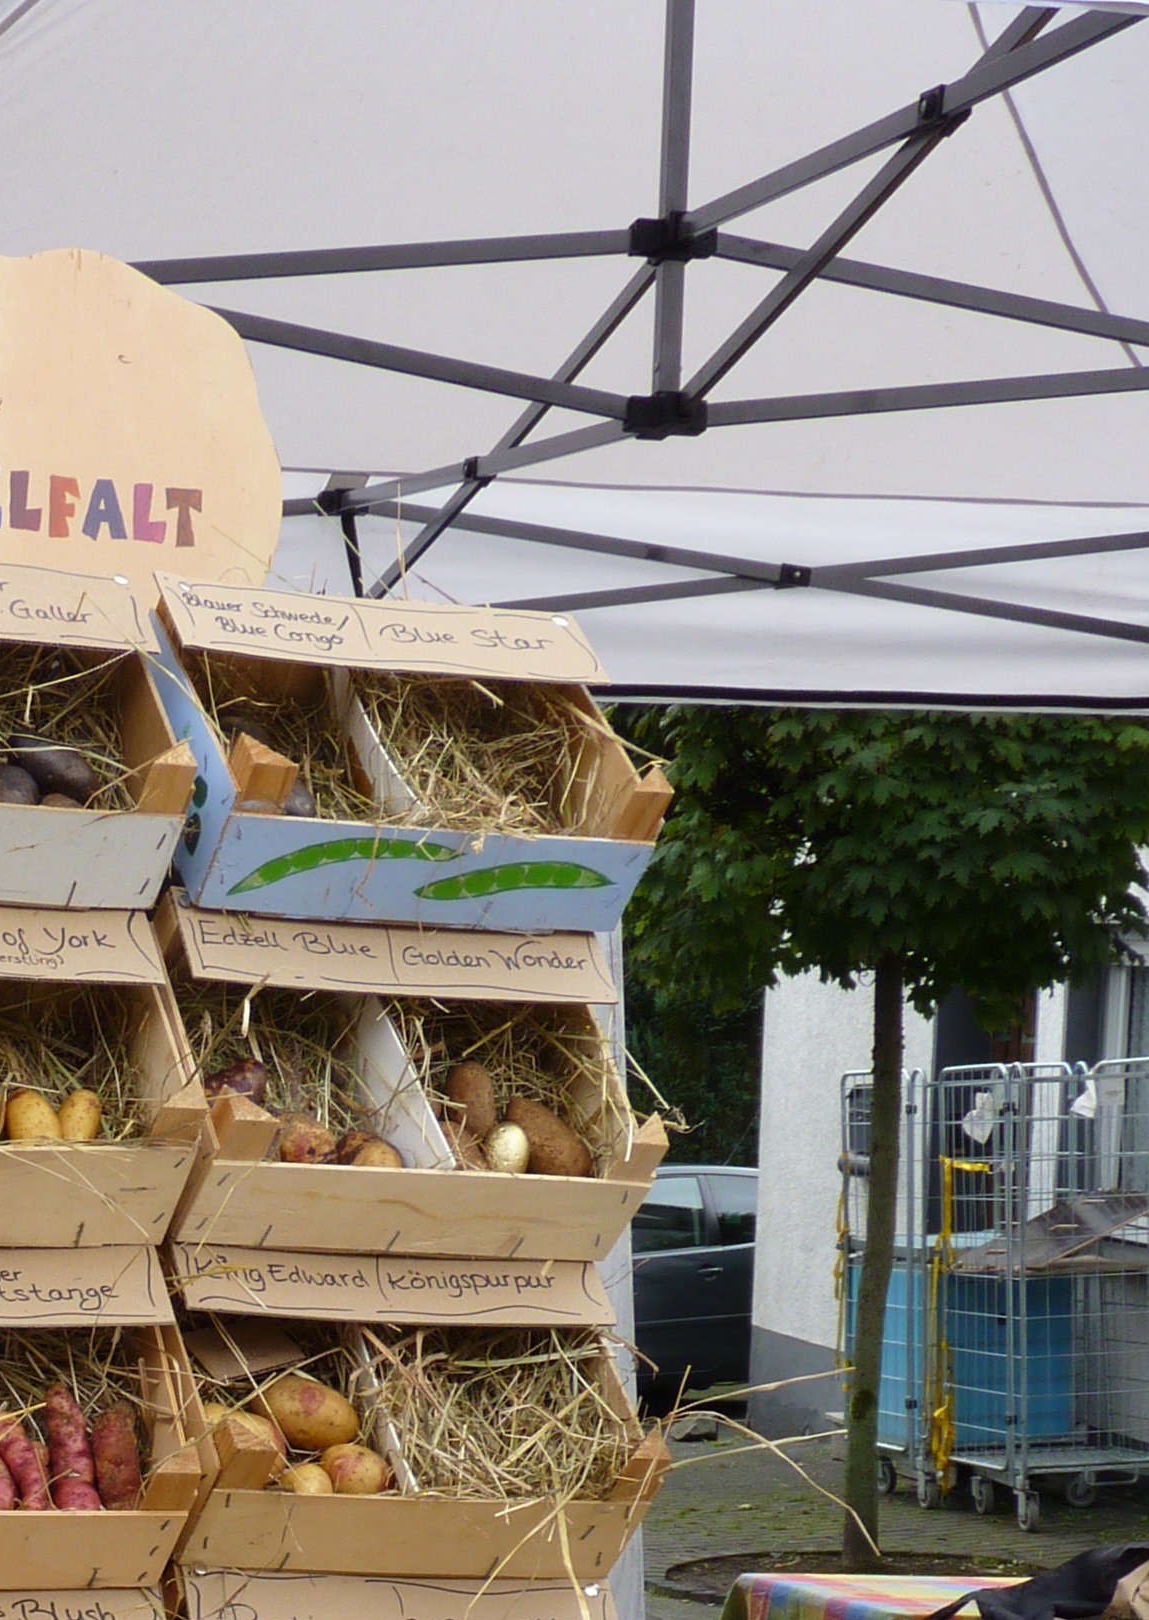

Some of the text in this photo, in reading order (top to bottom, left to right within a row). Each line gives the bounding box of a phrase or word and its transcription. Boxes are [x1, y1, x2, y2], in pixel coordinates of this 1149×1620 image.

[9, 599, 92, 623] Galler
[182, 592, 243, 612] Blauer
[215, 616, 344, 651] Blue Congo
[380, 621, 554, 650] Blue Star
[2, 927, 27, 953] of
[34, 927, 116, 956] York
[200, 920, 378, 958] Edzell Blue
[402, 941, 587, 970] Golden Wonder
[267, 1264, 370, 1288] Edward
